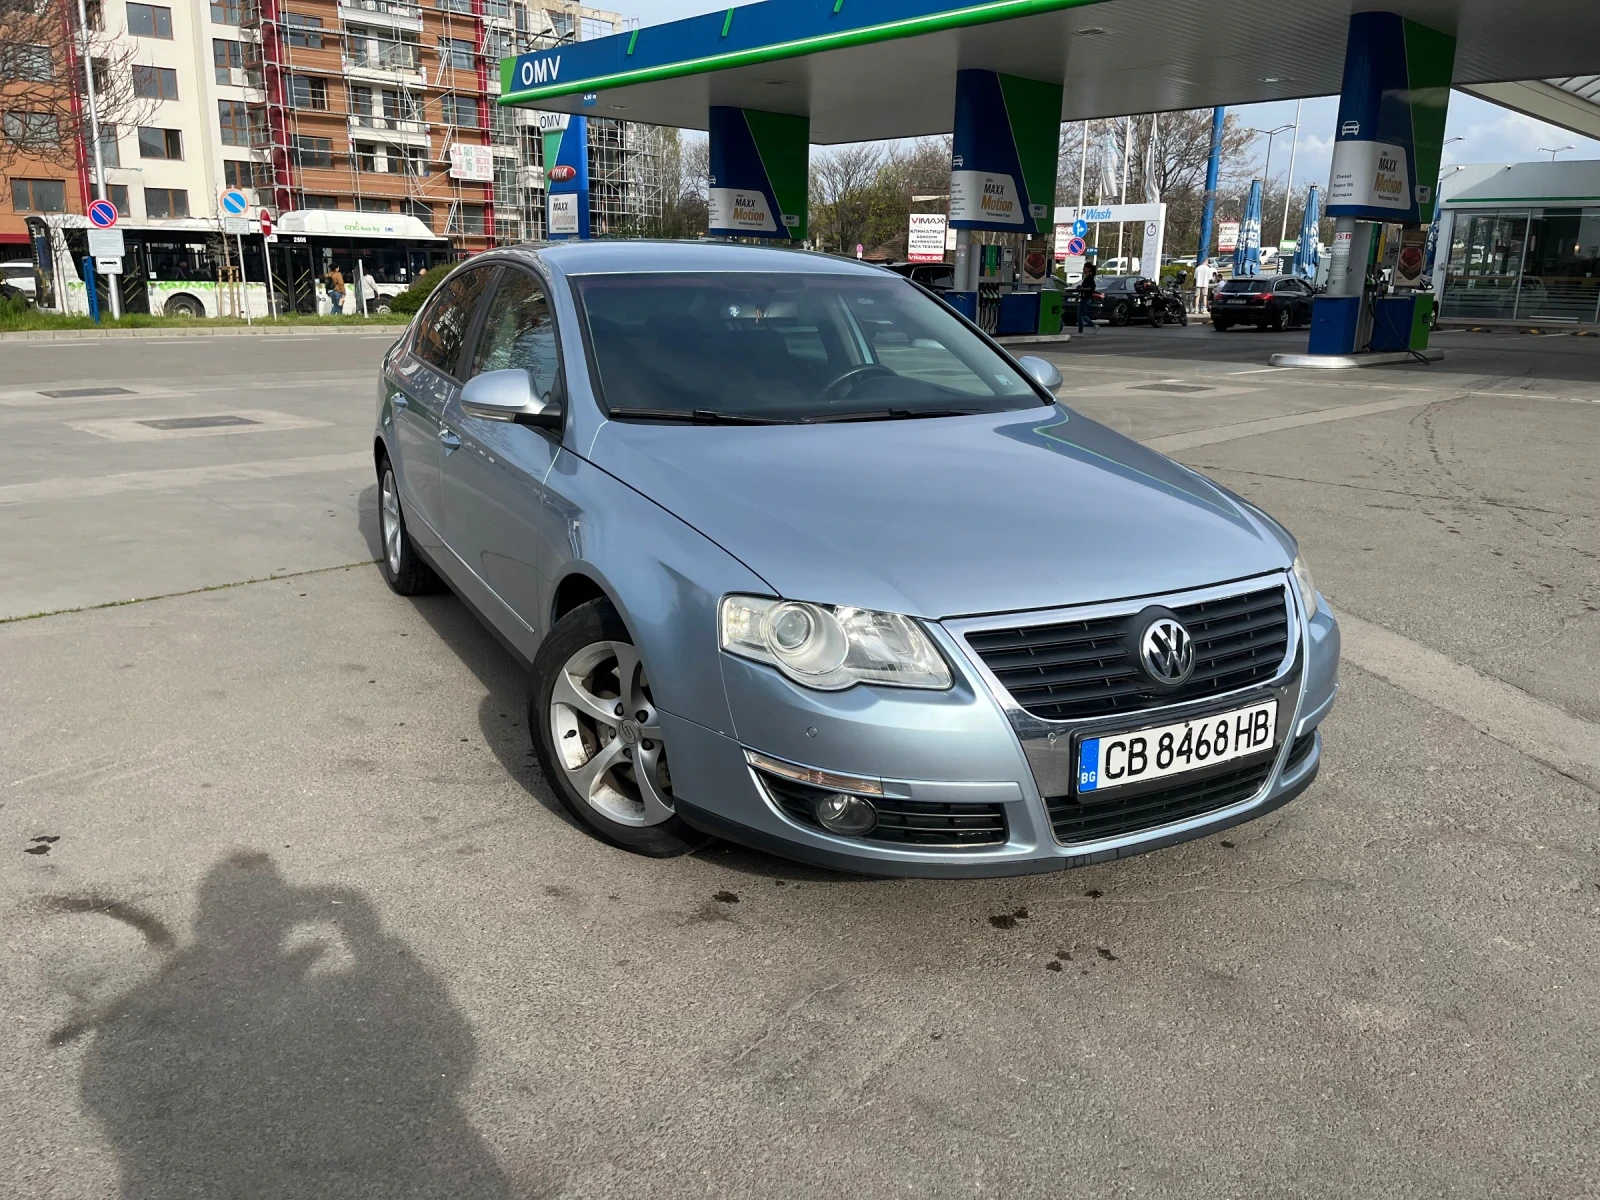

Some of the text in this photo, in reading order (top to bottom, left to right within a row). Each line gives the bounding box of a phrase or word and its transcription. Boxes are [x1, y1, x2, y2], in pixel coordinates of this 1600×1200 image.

[521, 55, 561, 86] OMV
[540, 114, 560, 128] OMV
[1378, 158, 1398, 172] MAXX
[552, 168, 568, 179] VIVA
[984, 184, 1005, 195] MAXX
[1374, 172, 1403, 194] Motion
[553, 202, 568, 212] MAXX
[735, 198, 756, 208] MAXX
[981, 194, 1013, 212] Motion
[552, 212, 576, 226] Motion
[733, 208, 764, 221] Motion
[1073, 208, 1112, 220] TP Wash
[1105, 709, 1269, 780] CB 8468 HB
[1081, 771, 1096, 784] BG
